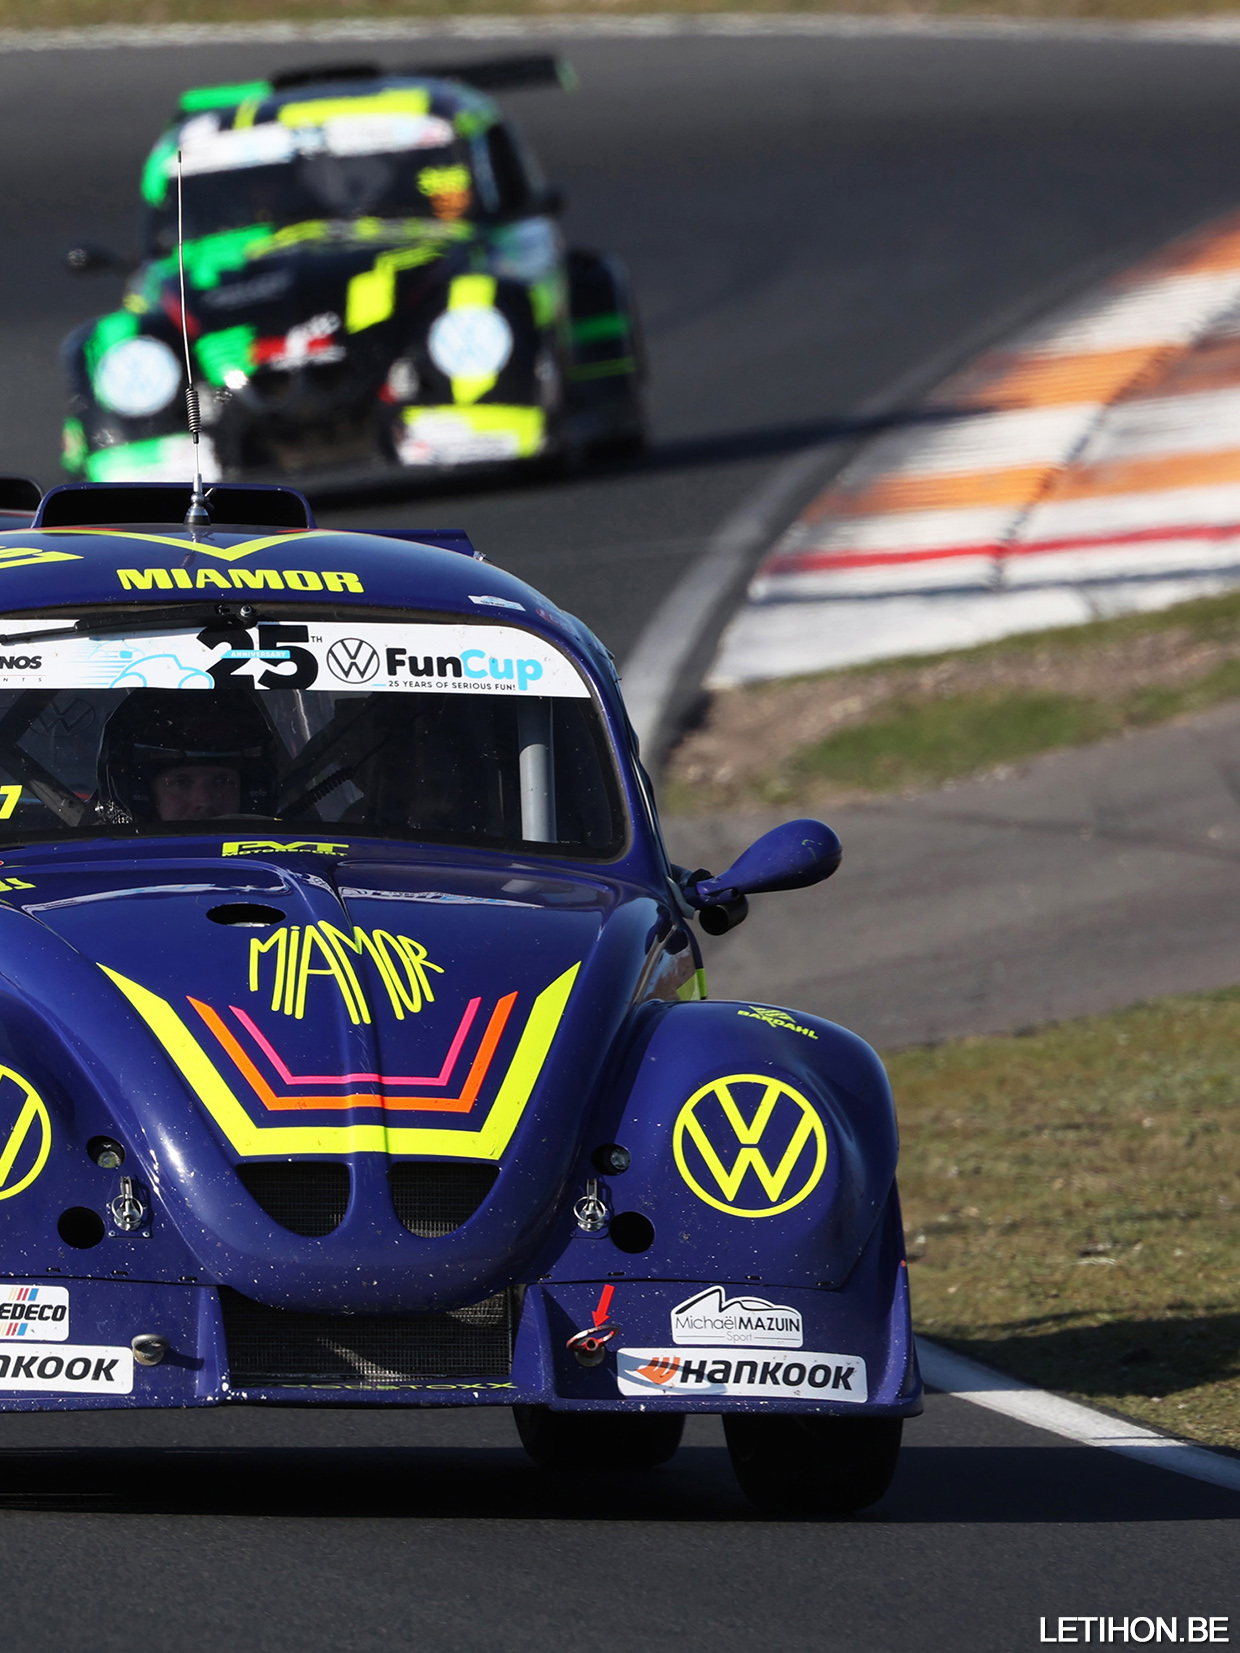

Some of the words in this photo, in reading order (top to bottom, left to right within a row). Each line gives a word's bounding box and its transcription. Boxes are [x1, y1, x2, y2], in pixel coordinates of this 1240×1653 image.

[116, 568, 365, 593] MIAMOR
[196, 624, 319, 690] 25
[386, 648, 543, 691] FunCup
[388, 680, 400, 688] 25
[403, 680, 432, 689] YEARS
[436, 681, 450, 689] OF
[452, 682, 492, 690] SERIOUS
[494, 683, 517, 691] FUN!
[249, 920, 445, 1025] MIAMOR
[737, 1009, 819, 1040] BARDAHL
